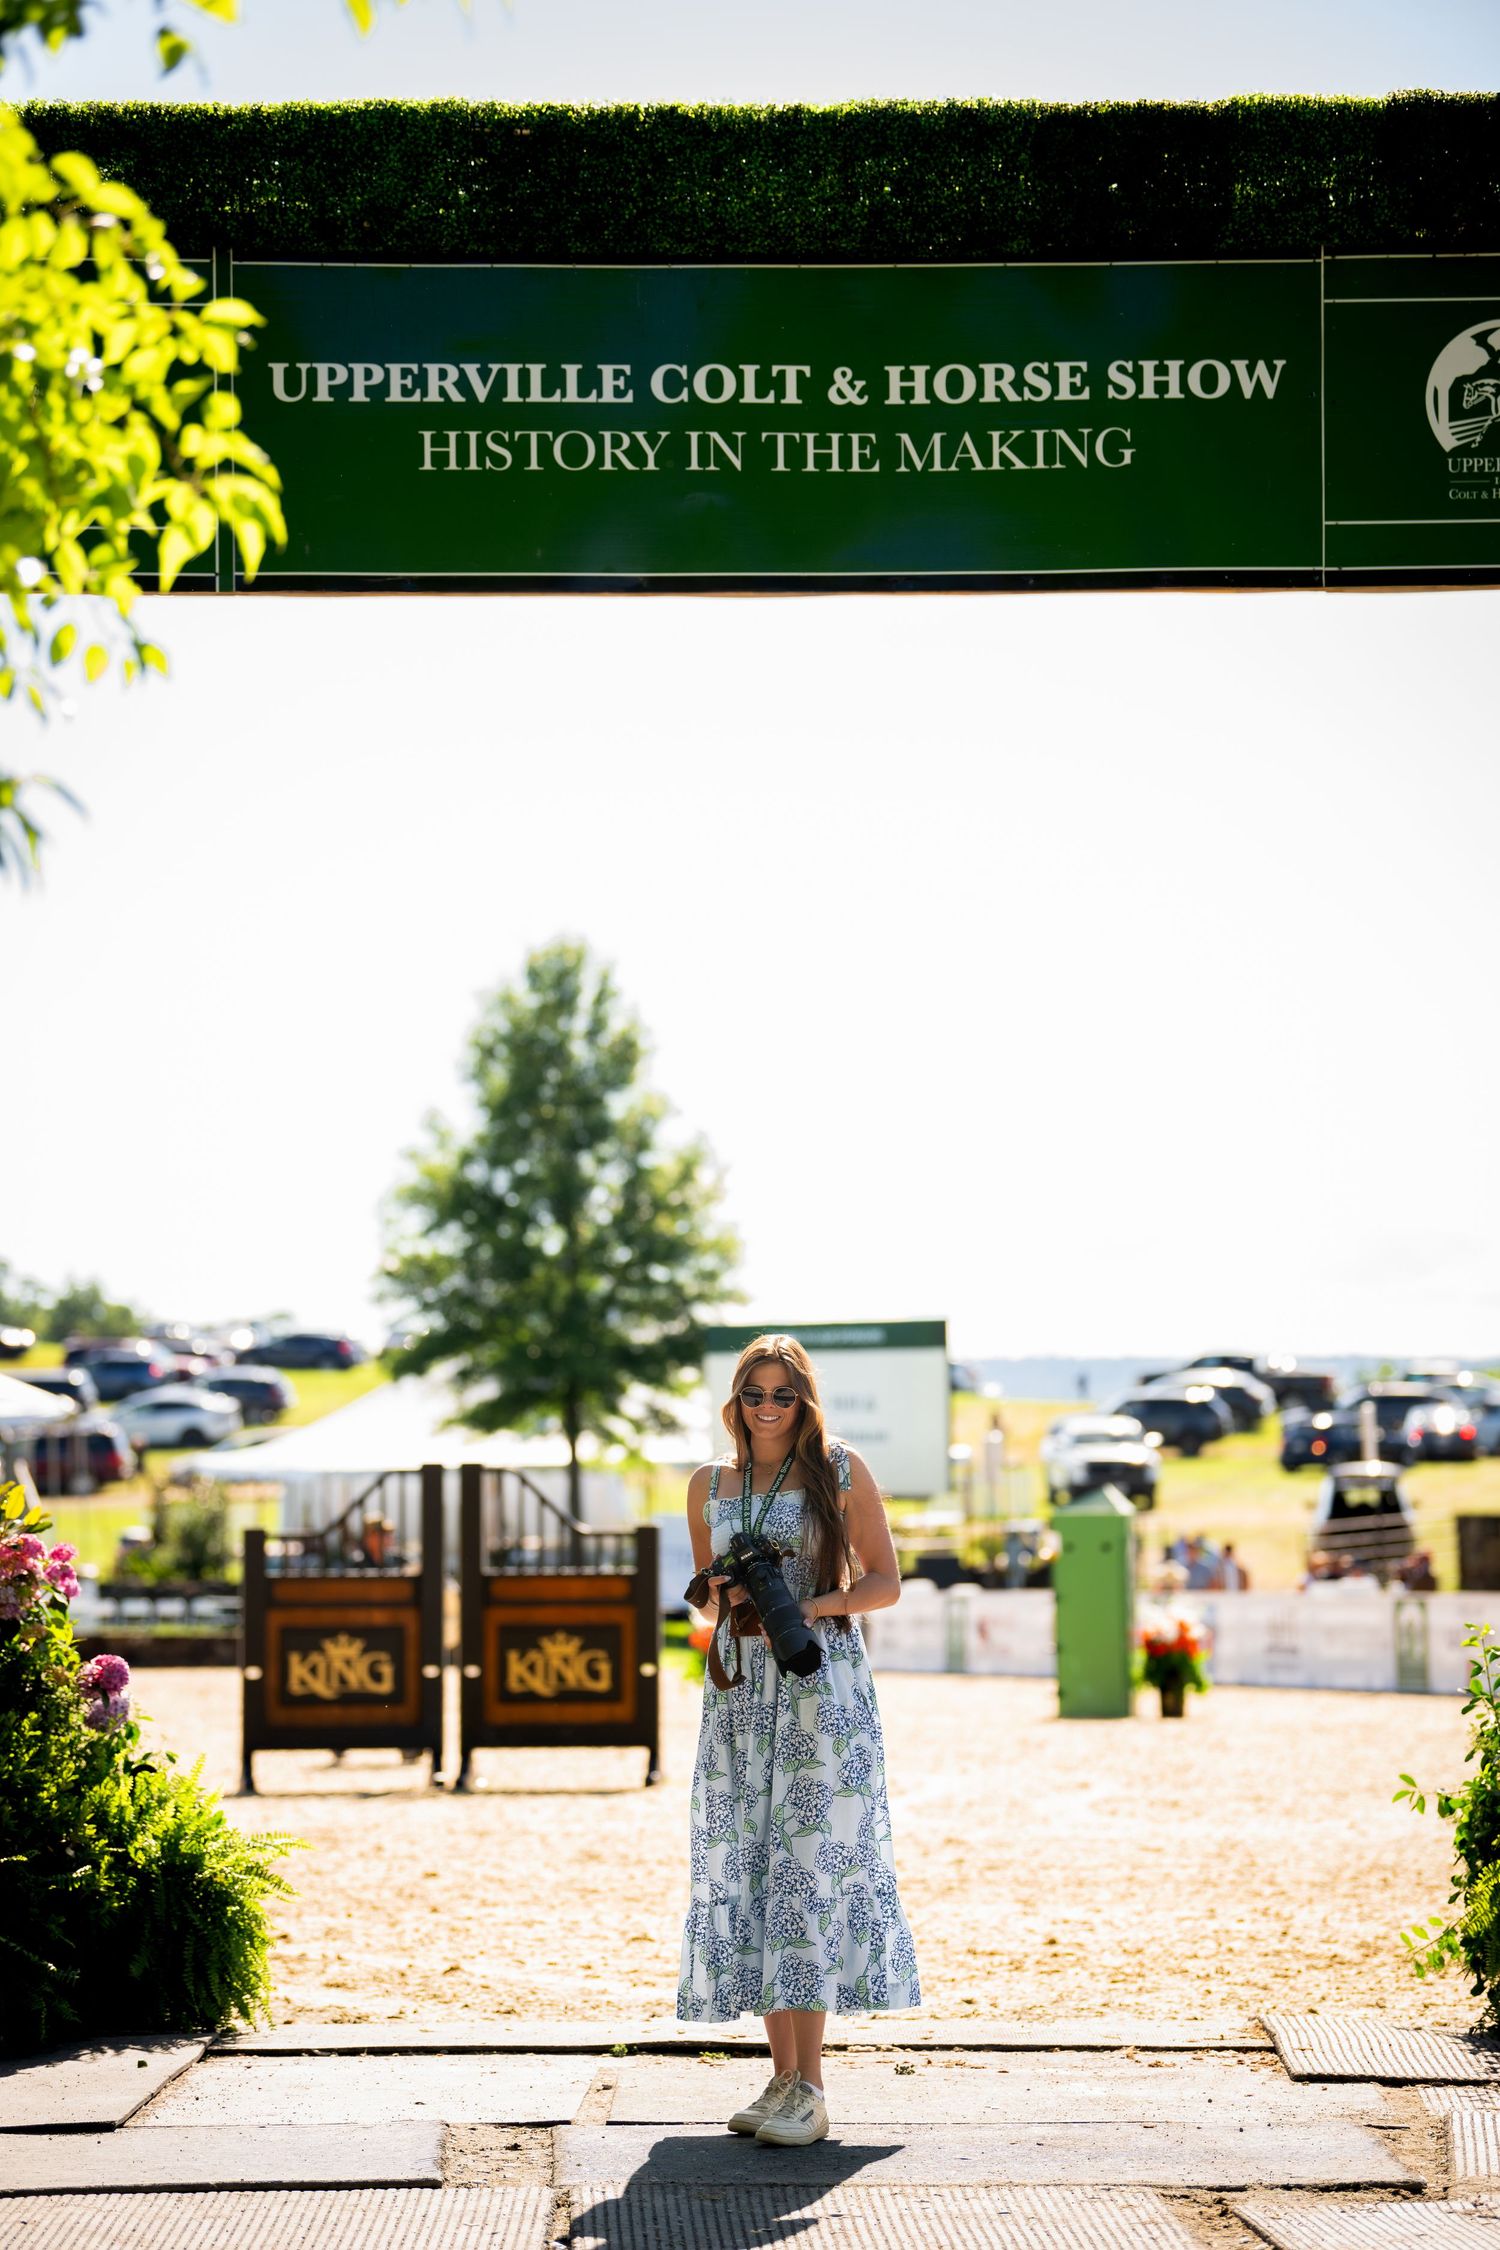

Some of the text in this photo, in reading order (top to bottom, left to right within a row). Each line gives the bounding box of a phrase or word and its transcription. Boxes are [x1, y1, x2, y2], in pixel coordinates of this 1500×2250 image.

[268, 359, 1287, 406] UPPERVILLE COLT & HORSE SHOW
[418, 427, 1137, 473] HISTORY IN THE MAKING
[1480, 490, 1489, 500] &
[287, 1649, 395, 1699] KING
[505, 1647, 613, 1698] KING
